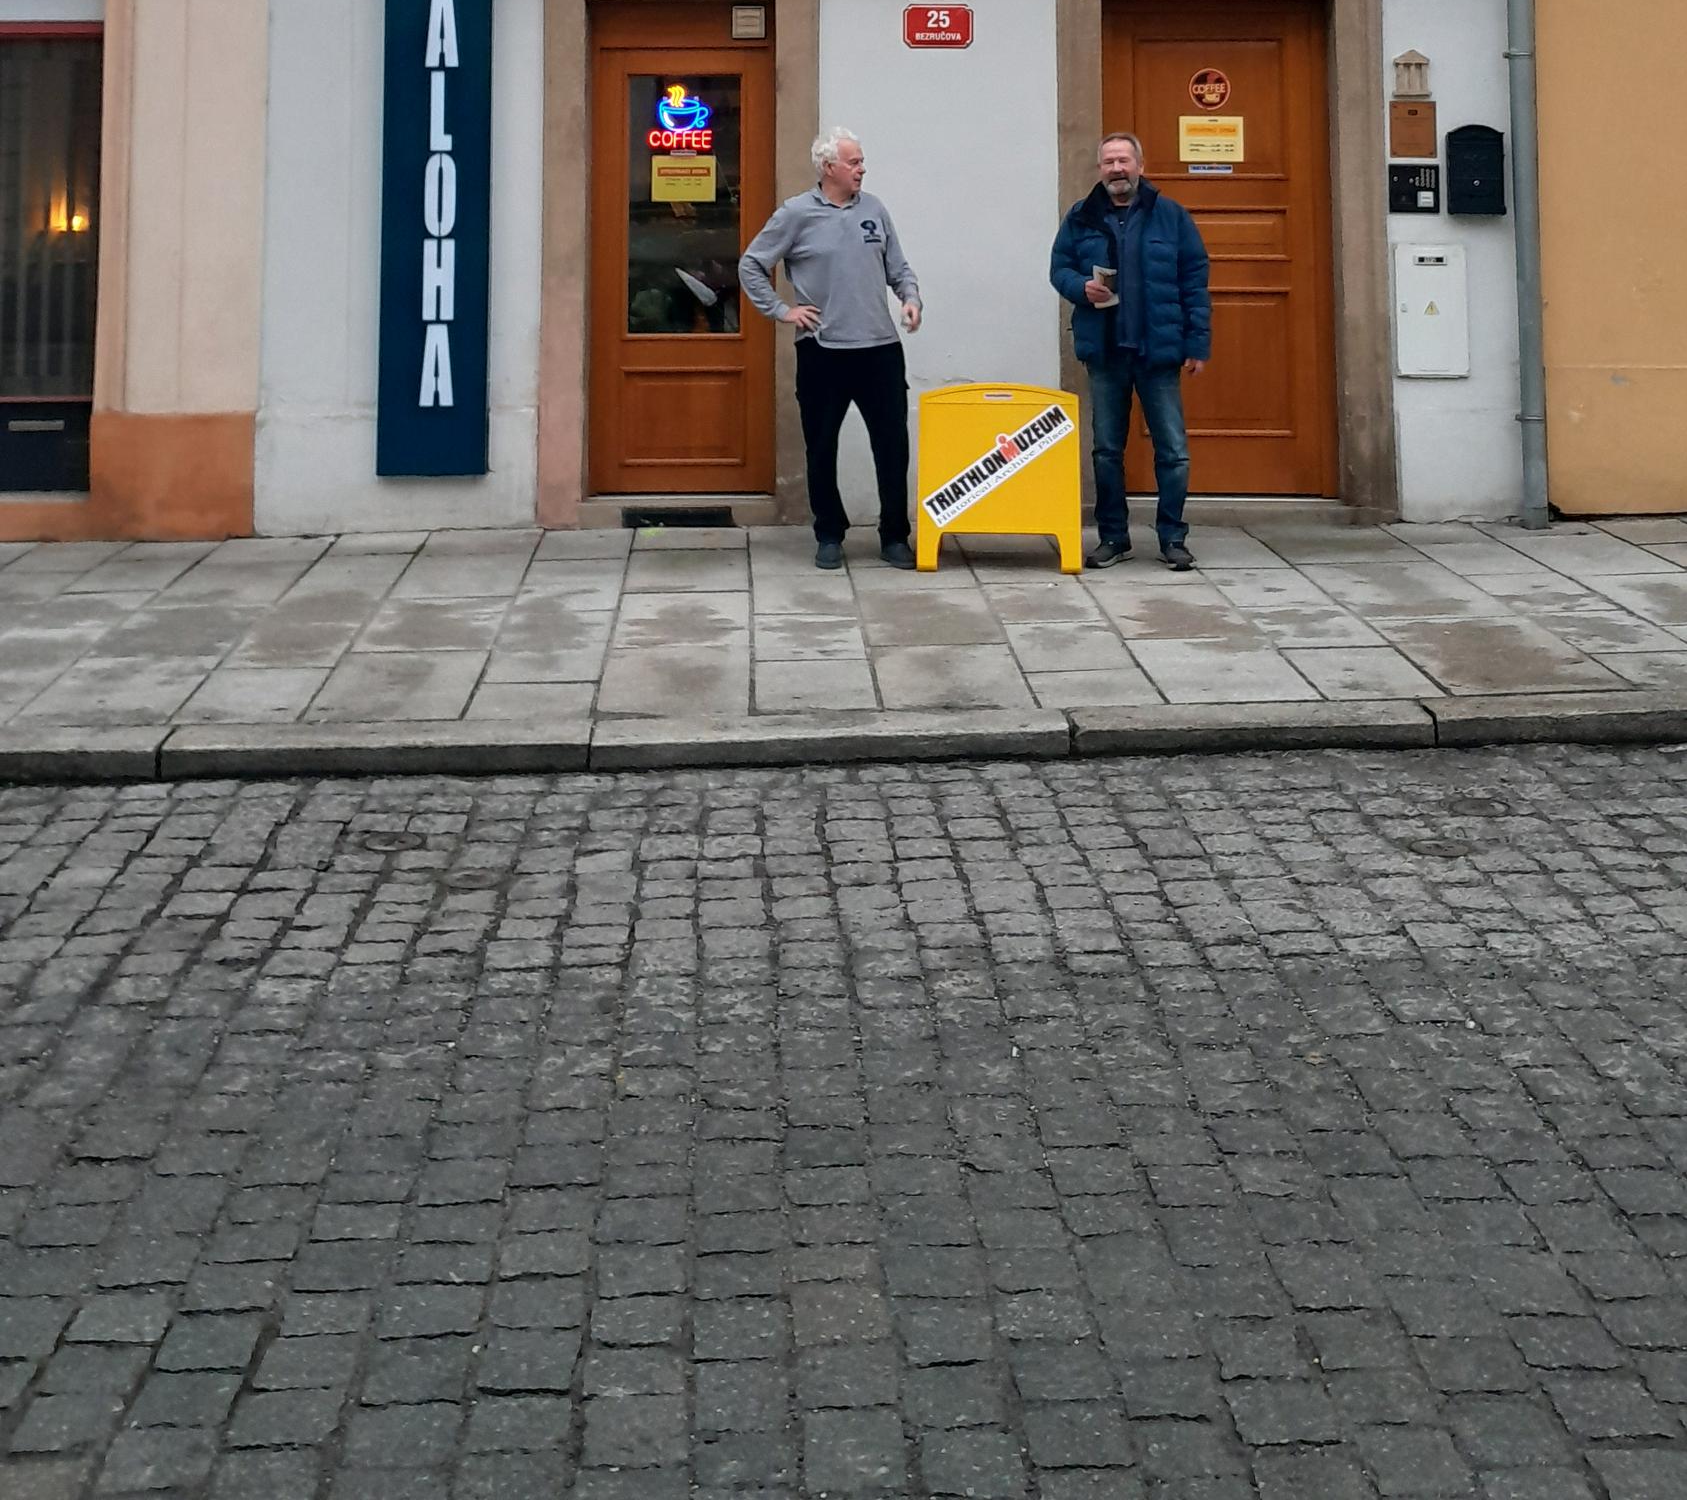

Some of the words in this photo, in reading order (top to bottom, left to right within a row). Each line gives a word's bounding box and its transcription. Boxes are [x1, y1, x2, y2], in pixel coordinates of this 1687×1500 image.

[927, 10, 950, 28] 25
[915, 31, 962, 40] BEZRUČOVA
[1192, 83, 1226, 94] COFFEE
[649, 130, 712, 149] COFFEE
[926, 406, 1067, 516] TRIATHLONMUZEUM
[937, 482, 991, 525] Historical
[994, 449, 1037, 483] Archive
[1038, 423, 1073, 450] Pilsen
